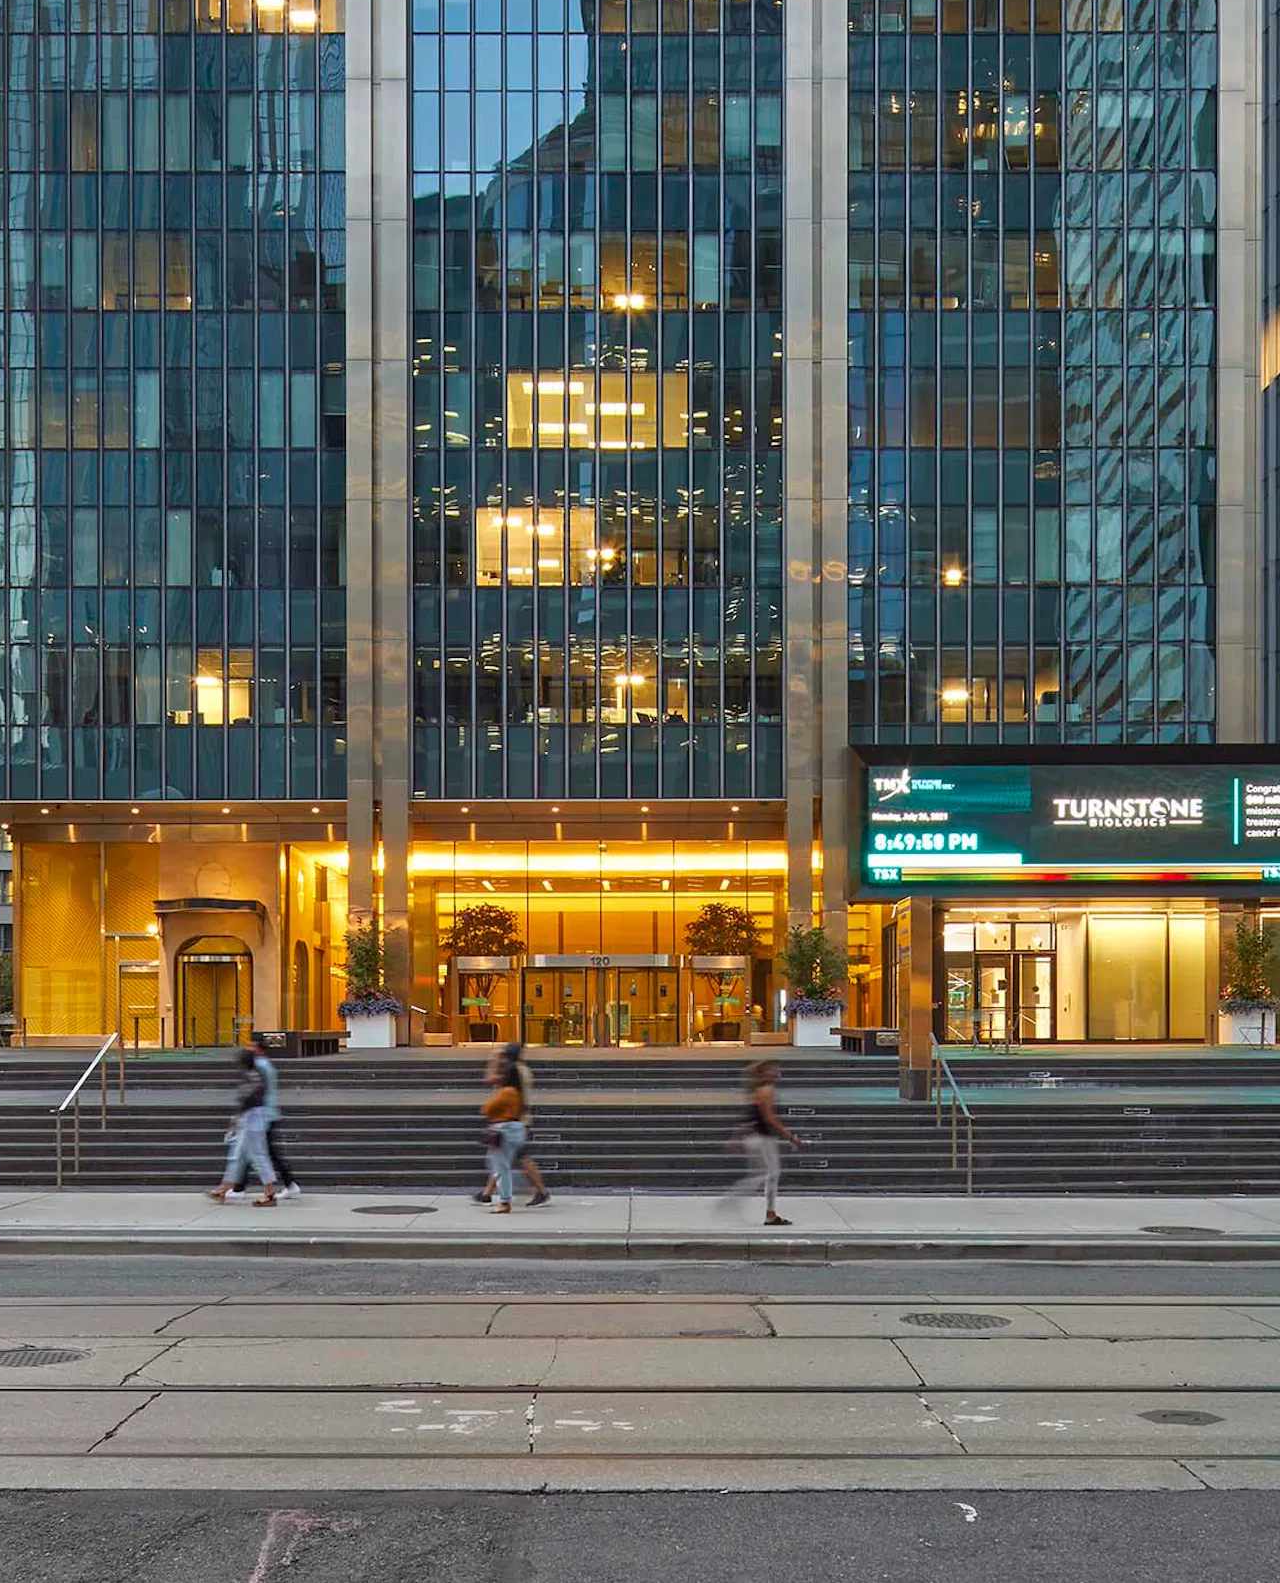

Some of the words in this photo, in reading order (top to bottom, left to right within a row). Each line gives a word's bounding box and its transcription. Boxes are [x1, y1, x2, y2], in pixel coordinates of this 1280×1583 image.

[873, 769, 911, 796] TMX
[1053, 798, 1203, 818] TURNSTONE
[1246, 806, 1280, 815] mission
[1088, 818, 1167, 827] BIOLOGICS
[948, 833, 978, 851] PM
[872, 868, 898, 879] TSX
[590, 956, 610, 967] 120
